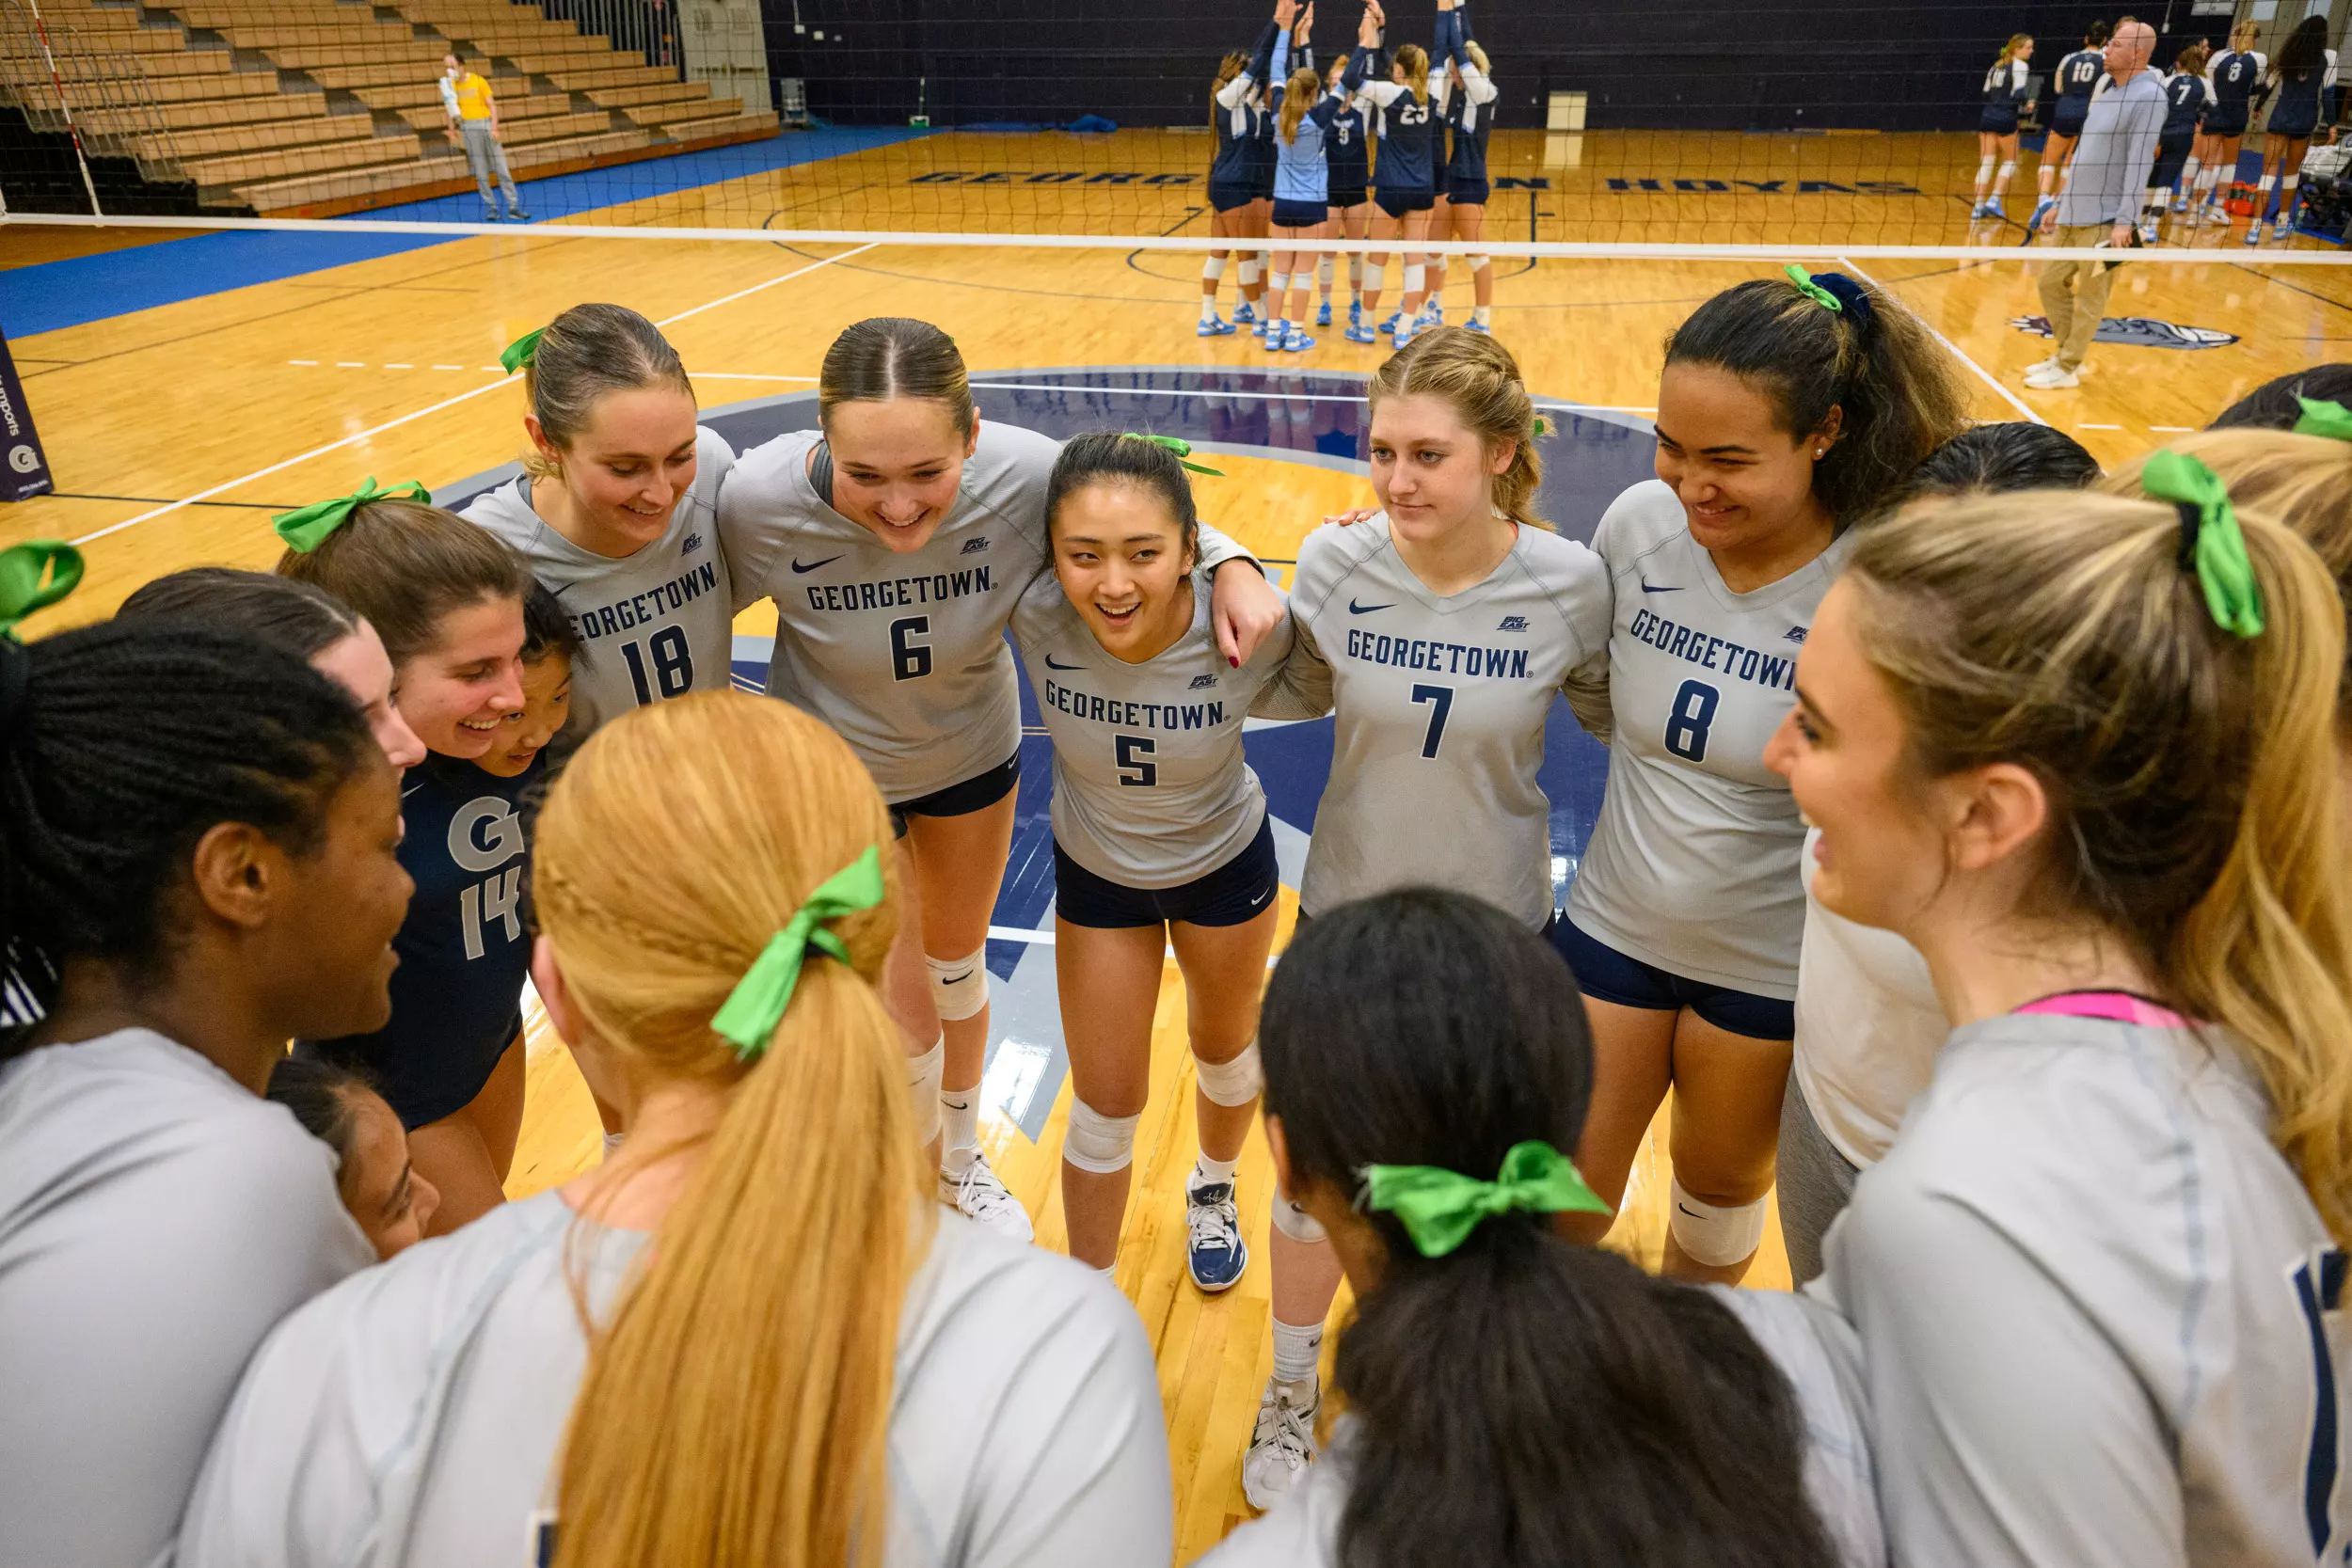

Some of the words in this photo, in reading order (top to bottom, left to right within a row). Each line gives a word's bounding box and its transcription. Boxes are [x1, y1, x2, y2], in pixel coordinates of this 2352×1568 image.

[2073, 61, 2095, 83] 10
[2176, 84, 2191, 105] 7
[2228, 62, 2243, 82] 8
[1339, 129, 1349, 145] 9
[1606, 178, 1923, 194] HOYAS
[962, 541, 991, 551] EAST
[568, 562, 717, 641] EORGETOWN
[806, 565, 991, 610] GEORGETOWN
[618, 624, 695, 710] 18
[888, 614, 933, 682] 6
[1347, 628, 1529, 678] GEORGETOWN
[1045, 678, 1223, 731] GEORGETOWN
[1189, 678, 1218, 687] EAST
[1409, 681, 1455, 761] 7
[1663, 676, 1722, 764] 8
[1113, 733, 1159, 787] 5
[447, 796, 525, 872] G
[460, 865, 521, 960] 14
